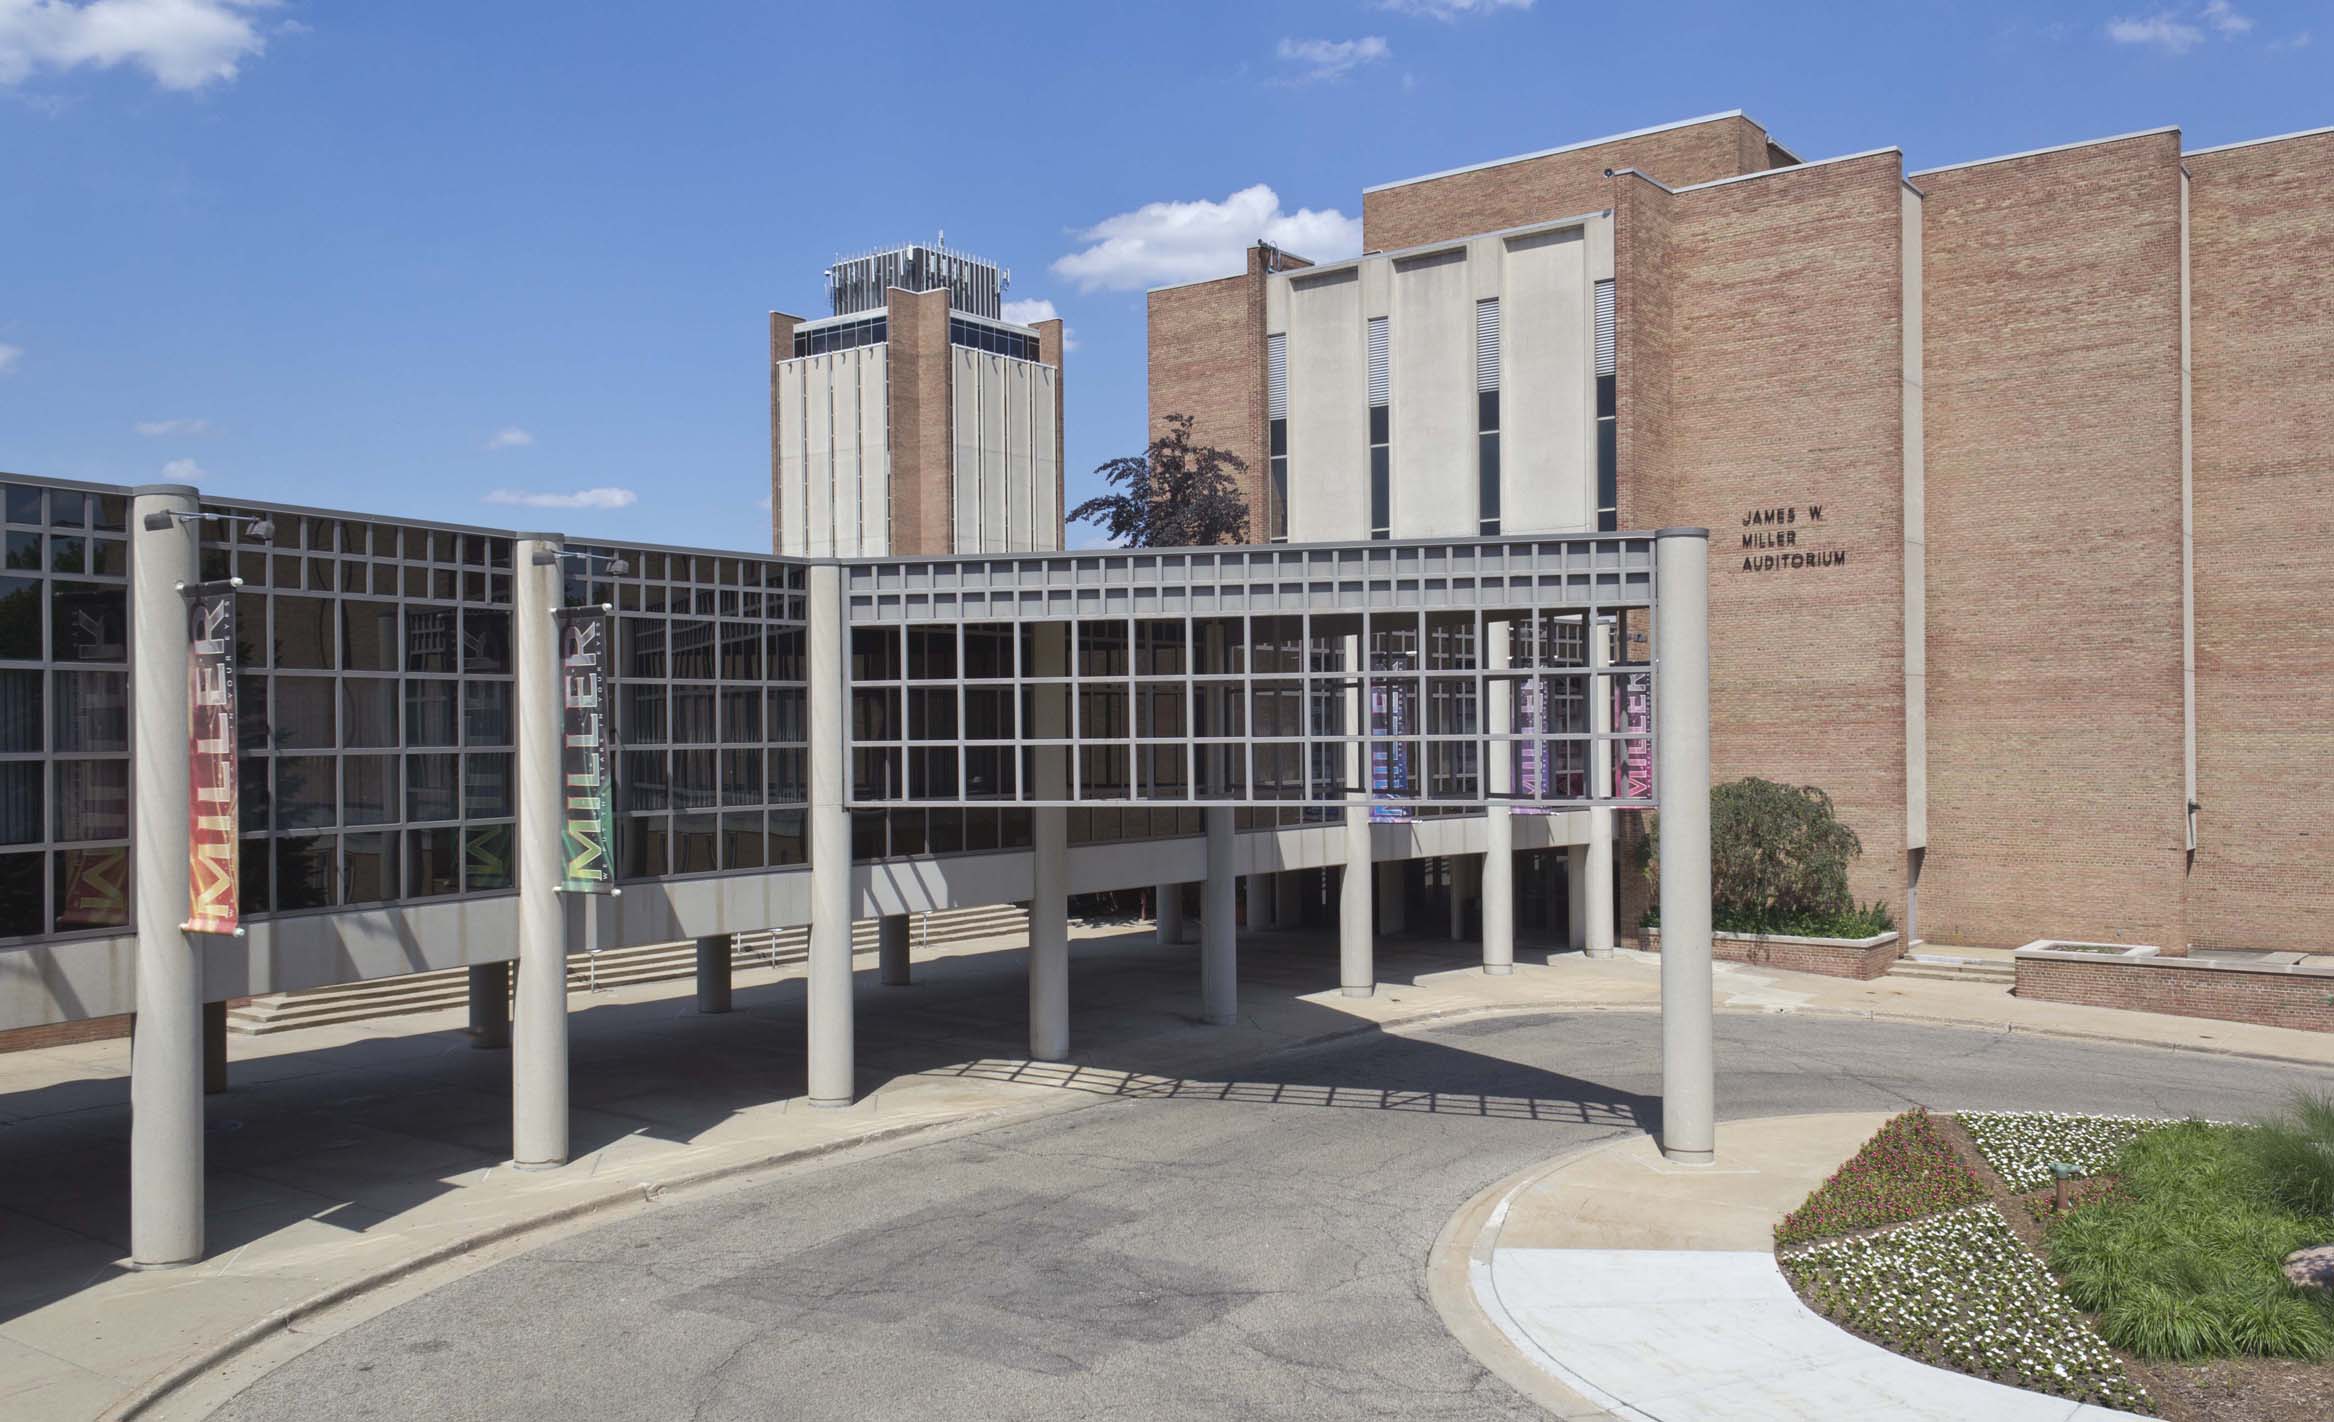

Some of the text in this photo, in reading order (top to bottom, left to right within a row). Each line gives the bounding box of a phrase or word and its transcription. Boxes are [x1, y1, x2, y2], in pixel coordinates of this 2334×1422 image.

[1742, 507, 1796, 527] JAMES
[1742, 530, 1796, 549] MILLER
[1742, 550, 1846, 573] AUDITORIUM
[194, 600, 231, 918] MILLER
[565, 621, 602, 881] MILLER
